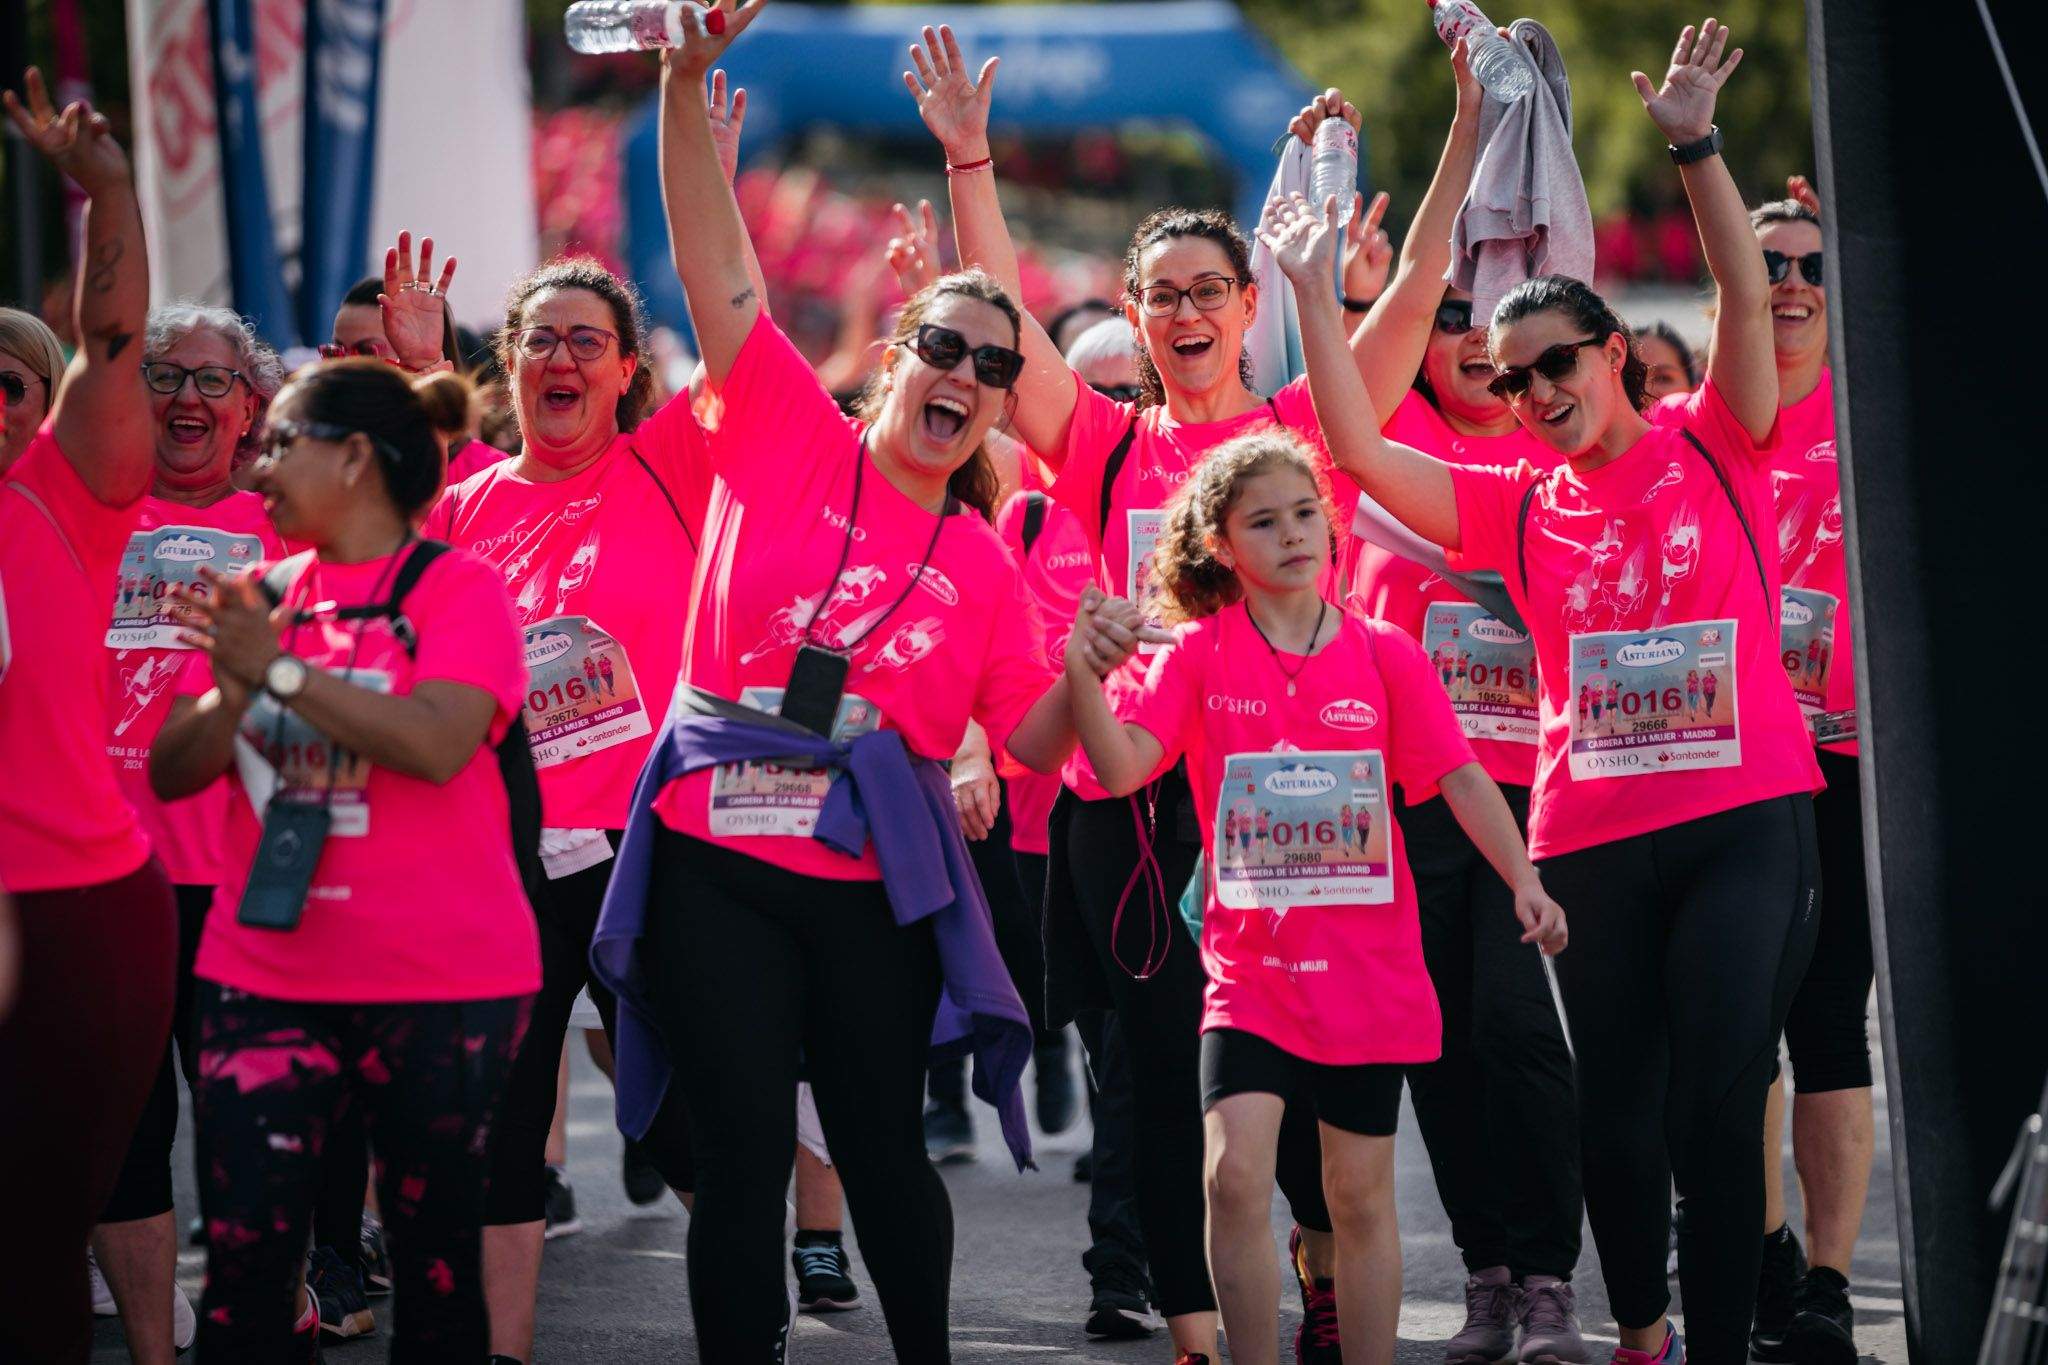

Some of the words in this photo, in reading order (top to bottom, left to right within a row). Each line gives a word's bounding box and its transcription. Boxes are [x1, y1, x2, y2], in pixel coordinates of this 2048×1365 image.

[110, 630, 157, 642] OYSHO
[1621, 648, 1681, 662] ASTURIANA
[1470, 664, 1525, 689] 016
[528, 677, 586, 712] 016
[1478, 691, 1511, 704] 10523
[1622, 687, 1682, 716] 016
[1469, 704, 1480, 712] DE
[1481, 704, 1490, 712] LA
[1491, 706, 1517, 715] MUJER
[542, 730, 553, 740] DE
[554, 727, 565, 736] LA
[564, 717, 590, 732] MUJER
[594, 706, 624, 721] MADRID
[545, 708, 580, 727] 29678
[1632, 719, 1668, 733] 29666
[587, 723, 632, 744] Santander
[1588, 738, 1623, 749] CARRERA
[1625, 736, 1636, 745] DE
[1637, 735, 1648, 744] LA
[1649, 732, 1677, 742] MUJER
[1683, 729, 1717, 740] MADRID
[1587, 754, 1639, 769] OYSHO
[1670, 750, 1720, 762] Santander
[1271, 777, 1333, 790] ASTURIANA
[766, 796, 777, 805] DE
[778, 797, 790, 806] LA
[726, 814, 778, 826] OYSHO
[1272, 820, 1337, 846] 016
[1284, 852, 1322, 863] 29680
[1237, 867, 1275, 879] CARRERA
[1276, 867, 1287, 877] DE
[1289, 867, 1300, 876] LA
[1302, 866, 1330, 876] MUJER
[1337, 865, 1371, 875] MADRID
[1236, 885, 1290, 898] OYSHO
[1323, 885, 1375, 895] Santander
[1300, 959, 1329, 972] MUJER
